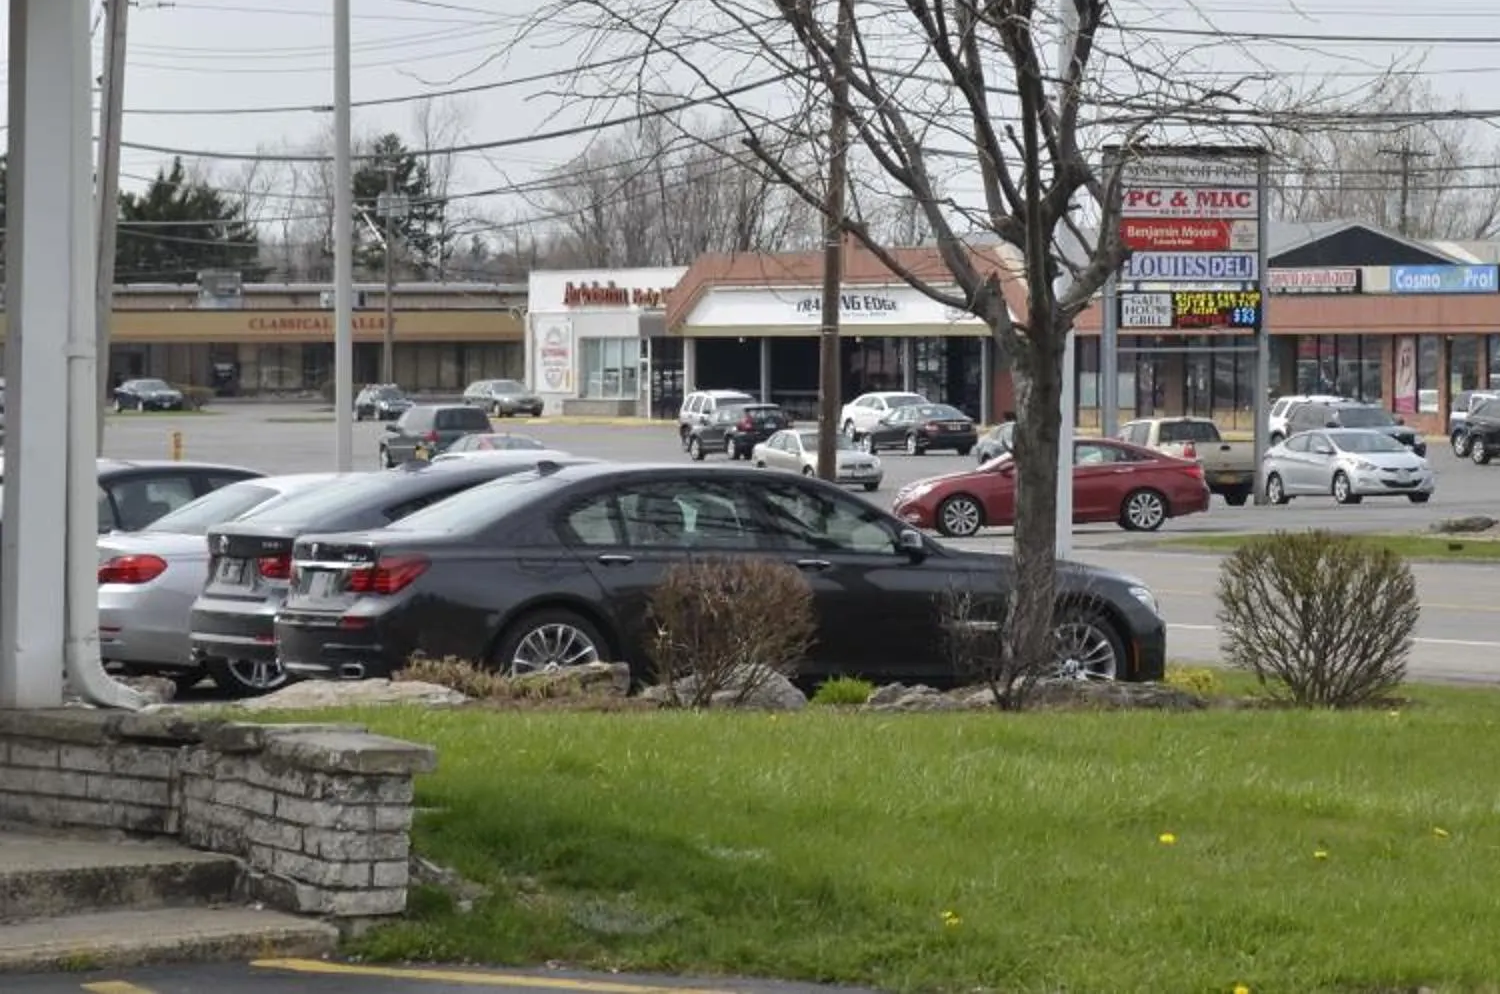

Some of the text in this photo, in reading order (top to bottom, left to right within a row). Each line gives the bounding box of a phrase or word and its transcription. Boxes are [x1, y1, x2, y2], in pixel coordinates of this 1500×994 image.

[1127, 190, 1251, 208] PC & MAC
[1213, 258, 1251, 277] DELI
[1395, 269, 1440, 289] Cosmo
